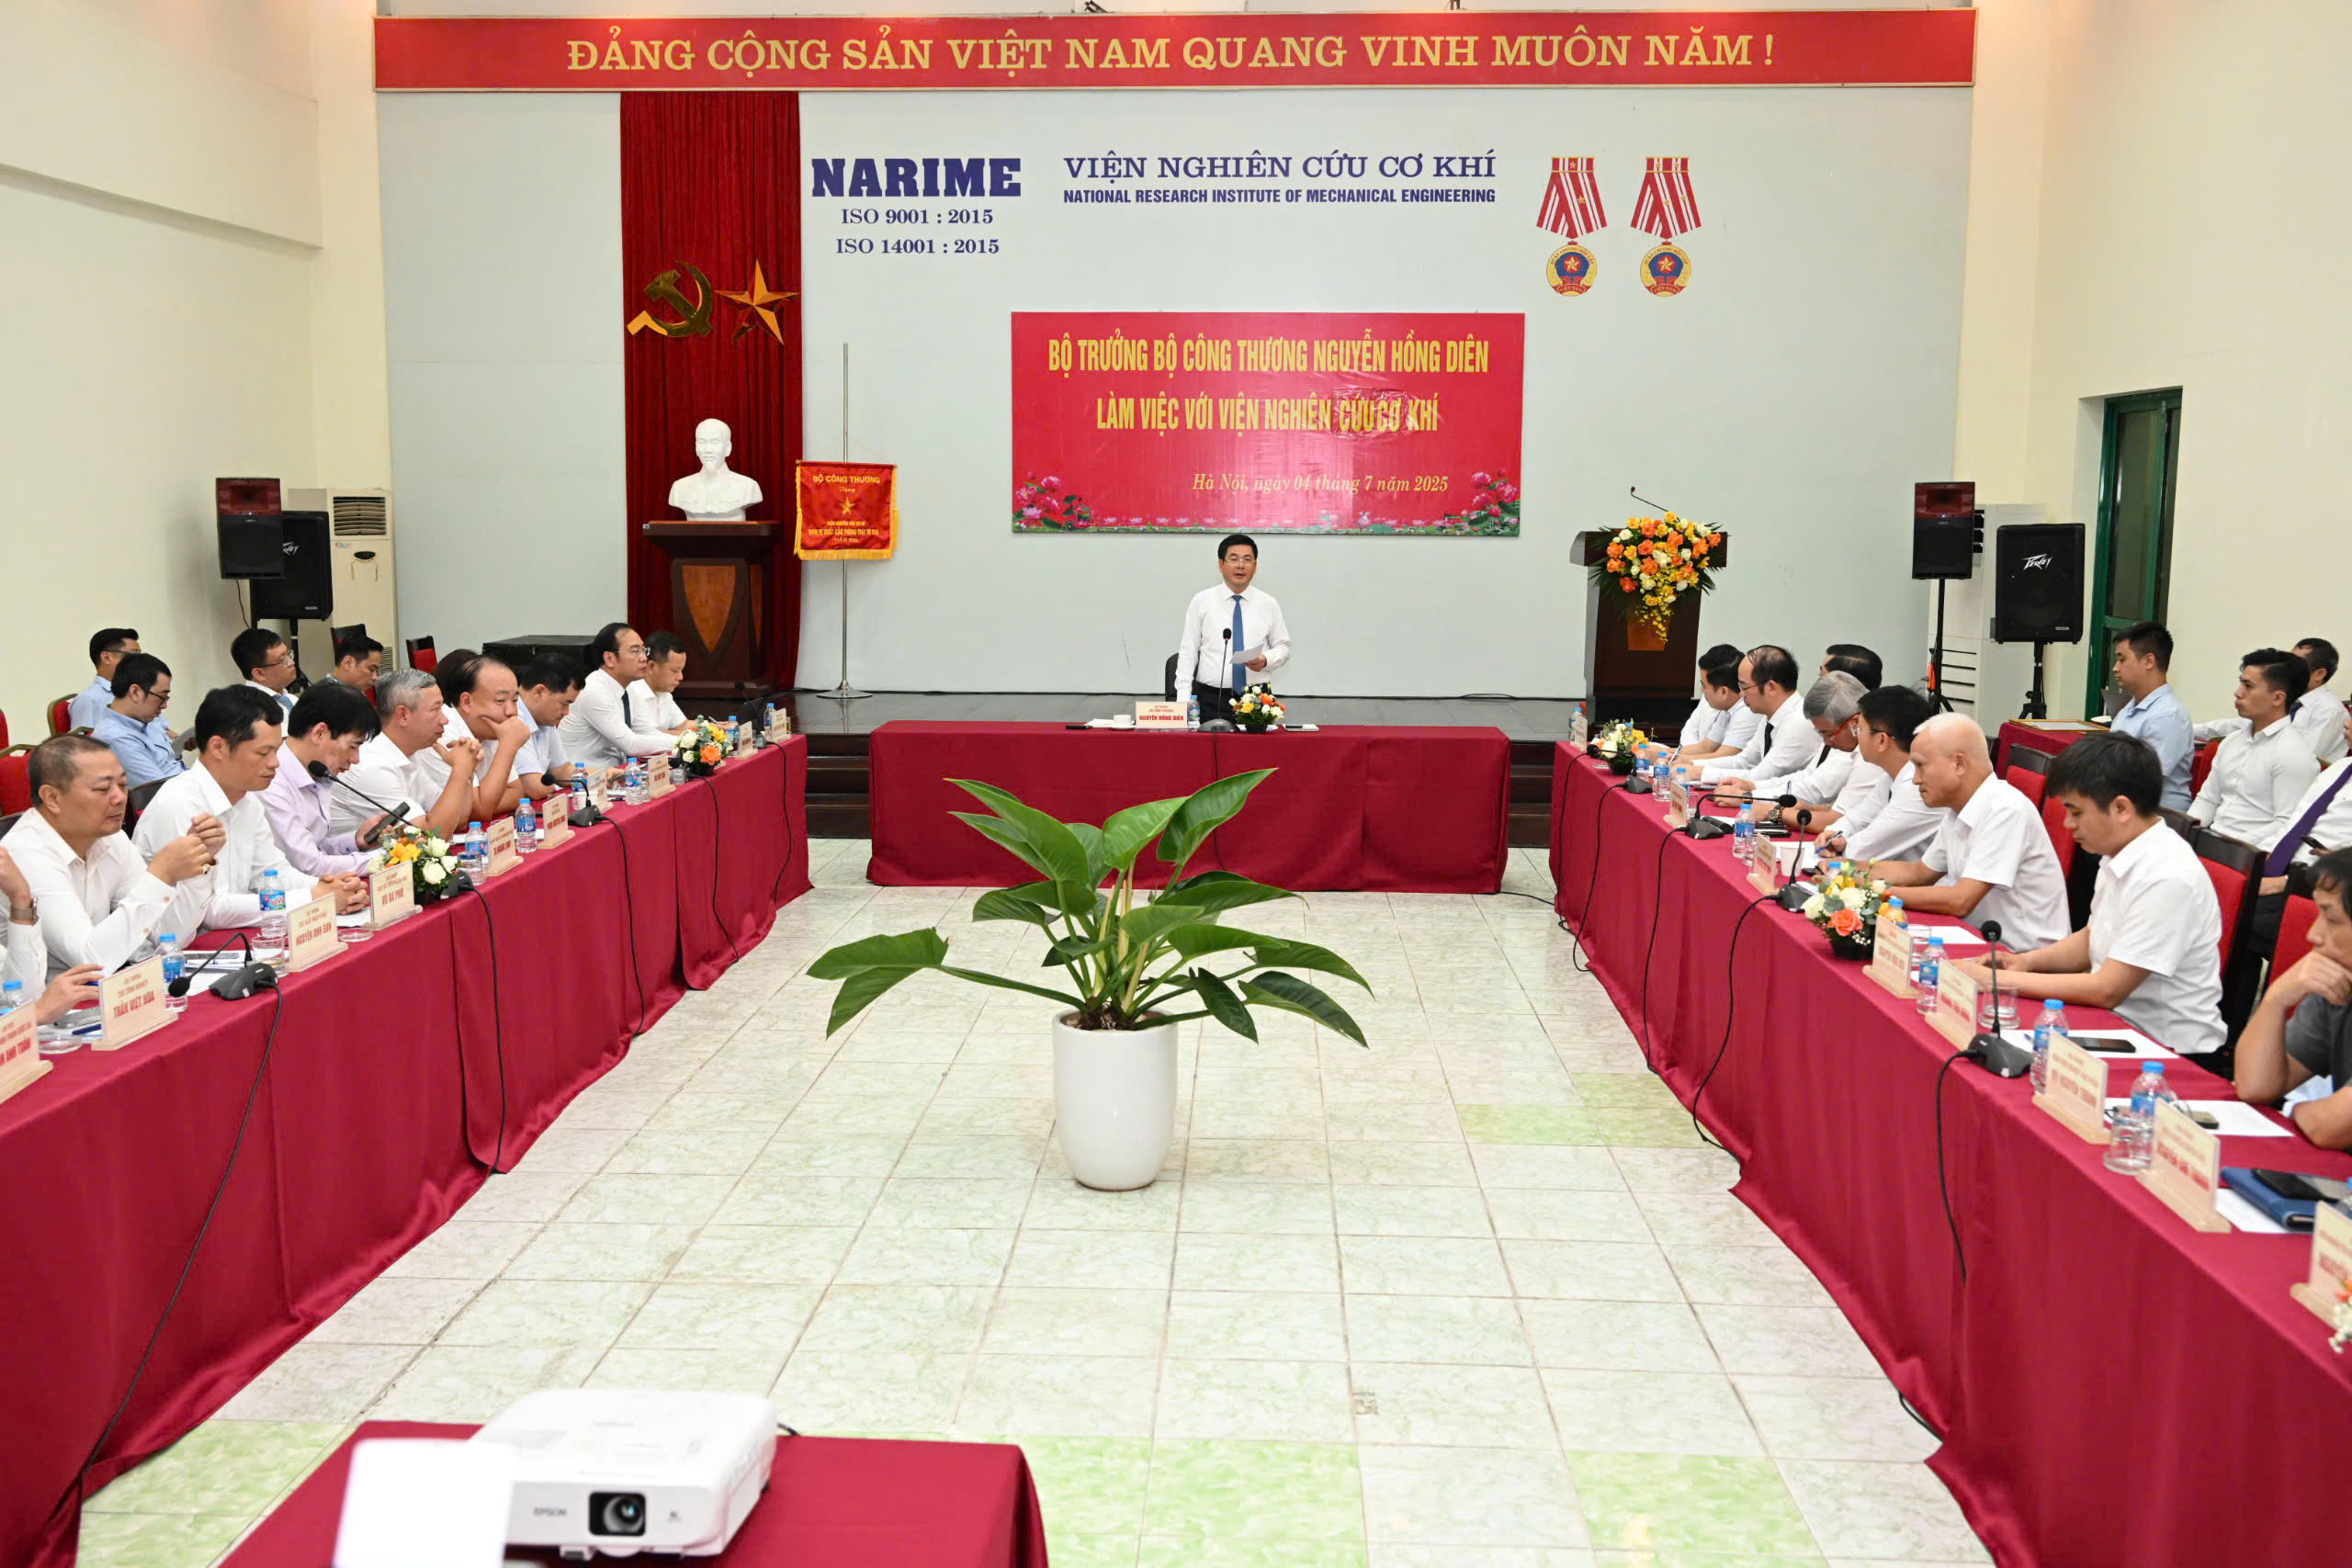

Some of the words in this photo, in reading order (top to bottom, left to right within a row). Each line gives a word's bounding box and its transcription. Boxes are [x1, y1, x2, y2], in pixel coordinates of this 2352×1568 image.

[567, 26, 695, 71] ĐẢNG
[707, 29, 831, 78] CỘNG
[842, 26, 933, 70] SẢN
[946, 28, 1052, 78] VIỆT
[1065, 38, 1170, 69] NAM
[1182, 36, 1348, 71] QUANG
[1360, 36, 1479, 67] VINH
[1491, 25, 1632, 67] MUÔN
[1644, 26, 1753, 66] NĂM
[811, 157, 1022, 197] NARIME
[1063, 150, 1148, 184] VIỆN
[1157, 149, 1293, 178] NGHIÊN
[1302, 149, 1368, 178] CỨU
[1378, 152, 1423, 178] CƠ
[1432, 148, 1497, 177] KHÍ
[1063, 189, 1132, 203] NATIONAL
[1135, 189, 1208, 203] RESEARCH
[1212, 189, 1281, 203] INSTITUTE
[1285, 189, 1303, 203] OF
[1306, 188, 1397, 203] MECHANICAL
[1401, 188, 1496, 203] ENGINEERING
[842, 209, 879, 224] ISO
[885, 209, 929, 224] 9001
[947, 209, 993, 224] 2015
[836, 238, 875, 254] ISO
[881, 239, 935, 254] 14001
[954, 239, 1000, 254] 2015
[1048, 332, 1072, 378] BỘ
[1077, 328, 1148, 372] TRƯỞNG
[1153, 332, 1178, 379] BỘ
[1182, 333, 1232, 372] CÔNG
[1237, 336, 1308, 372] THƯƠNG
[1313, 328, 1386, 372] NGUYỄN
[1391, 329, 1441, 373] HỒNG
[1446, 333, 1489, 373] DIÊN
[1097, 390, 1135, 430] LÀM
[1139, 390, 1180, 436] VIỆC
[1184, 391, 1214, 430] VỚI
[1219, 391, 1260, 437] VIỆN
[1264, 391, 1332, 431] NGHIÊN
[1408, 392, 1439, 432] KHÍ
[1192, 473, 1214, 491] Hà
[1220, 473, 1249, 496] Nội,
[1254, 474, 1290, 494] ngày
[1294, 474, 1311, 491] 04
[1316, 474, 1360, 493] tháng
[1364, 475, 1374, 491] 7
[1376, 476, 1410, 491] năm
[1413, 475, 1449, 492] 2025
